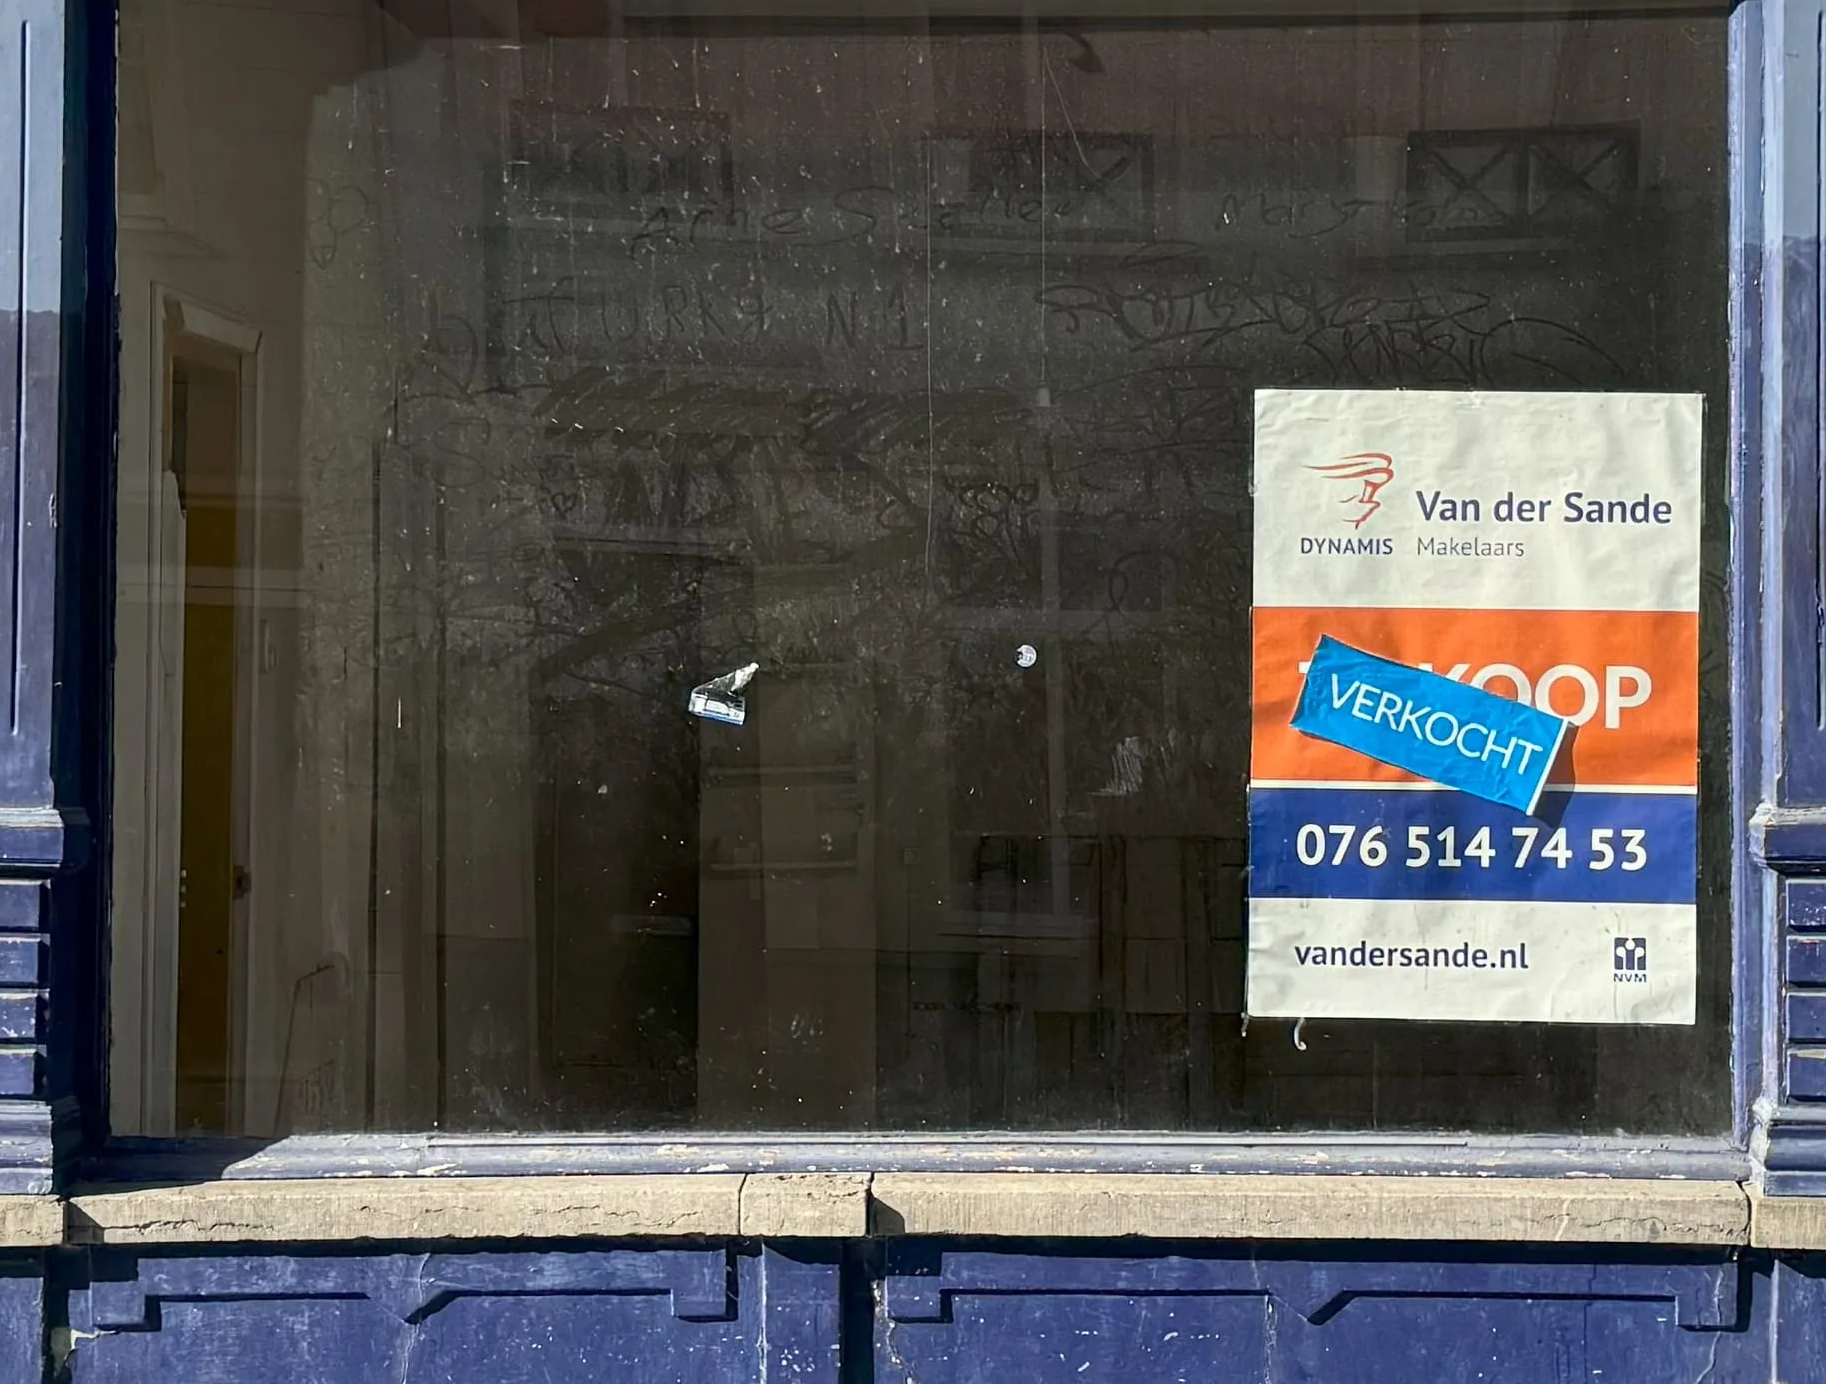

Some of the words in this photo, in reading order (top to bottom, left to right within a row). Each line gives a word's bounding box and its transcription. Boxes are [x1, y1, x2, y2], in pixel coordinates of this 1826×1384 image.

[1416, 491, 1480, 521] Van
[1494, 492, 1552, 522] der
[1564, 492, 1672, 523] Sande
[1300, 537, 1393, 555] DYNAMIS
[1416, 537, 1525, 557] Makelaars
[1421, 663, 1652, 729] OOP
[1331, 674, 1544, 775] VERKOCHT
[1296, 824, 1388, 866] 076
[1405, 825, 1496, 867] 514
[1511, 826, 1572, 869] 74
[1589, 828, 1647, 871] 53
[1294, 940, 1529, 969] vandersande.nl
[1614, 973, 1646, 983] NVM
